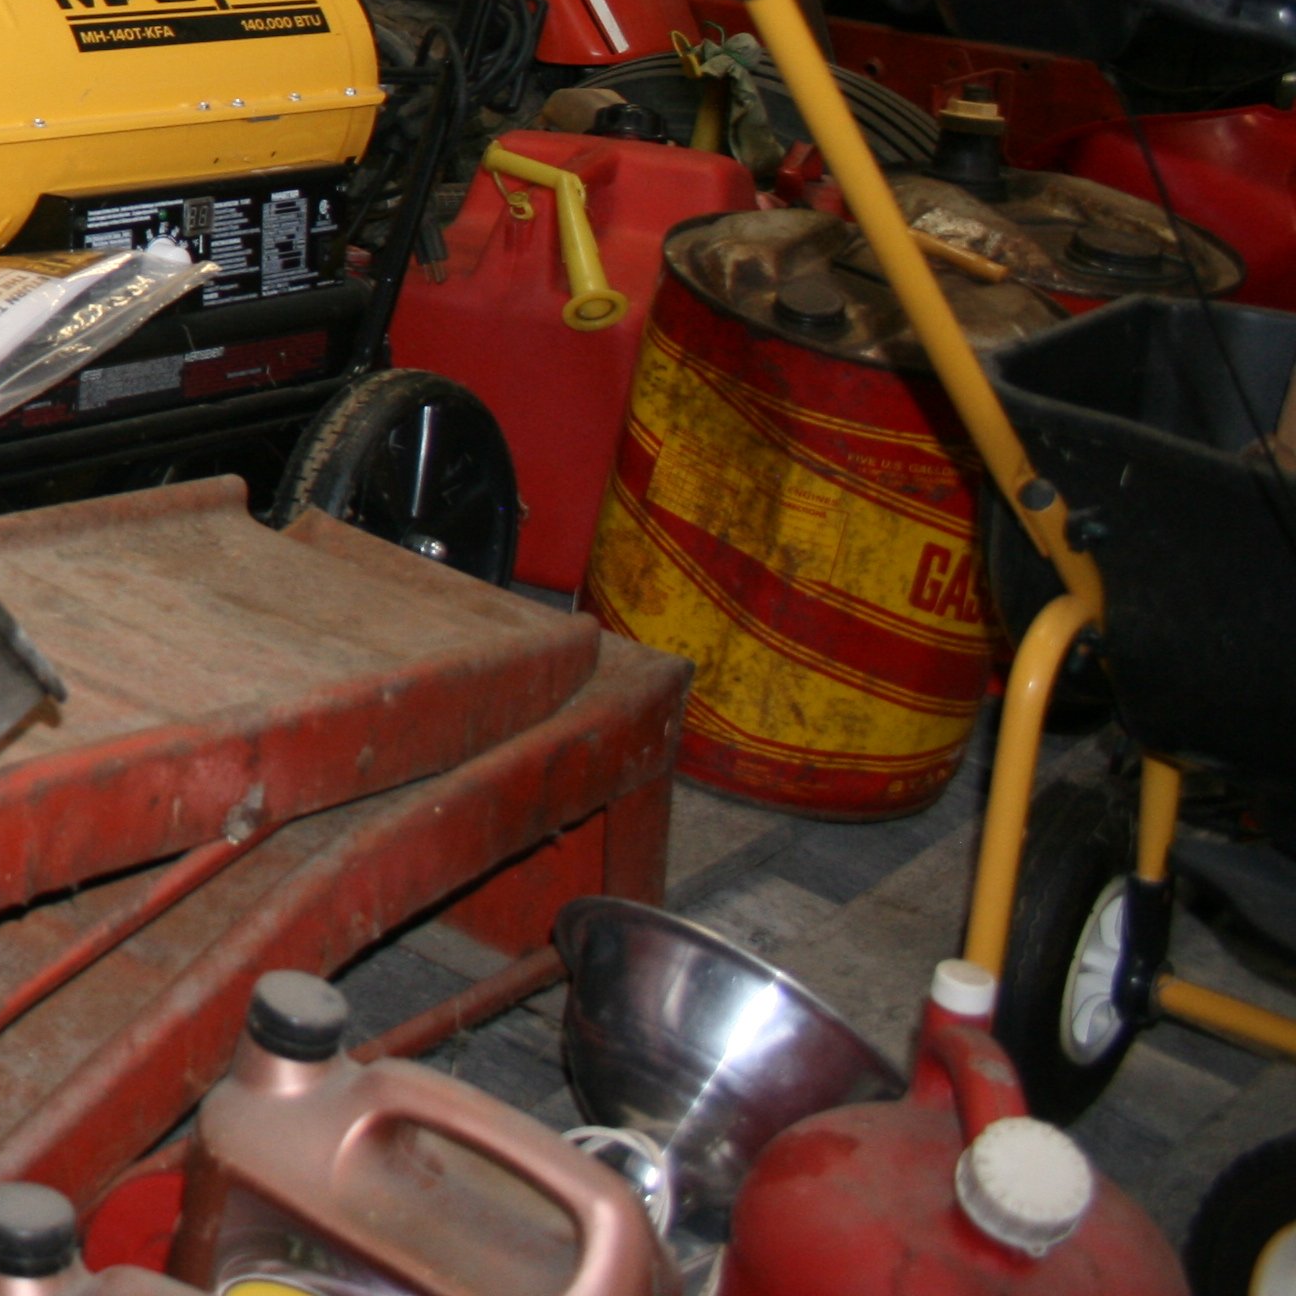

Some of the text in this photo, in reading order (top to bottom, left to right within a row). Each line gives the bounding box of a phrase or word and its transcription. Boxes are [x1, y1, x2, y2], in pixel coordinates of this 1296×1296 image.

[81, 15, 321, 43] MH-140T-KFA 140,000 BTU
[909, 463, 959, 477] GALLO
